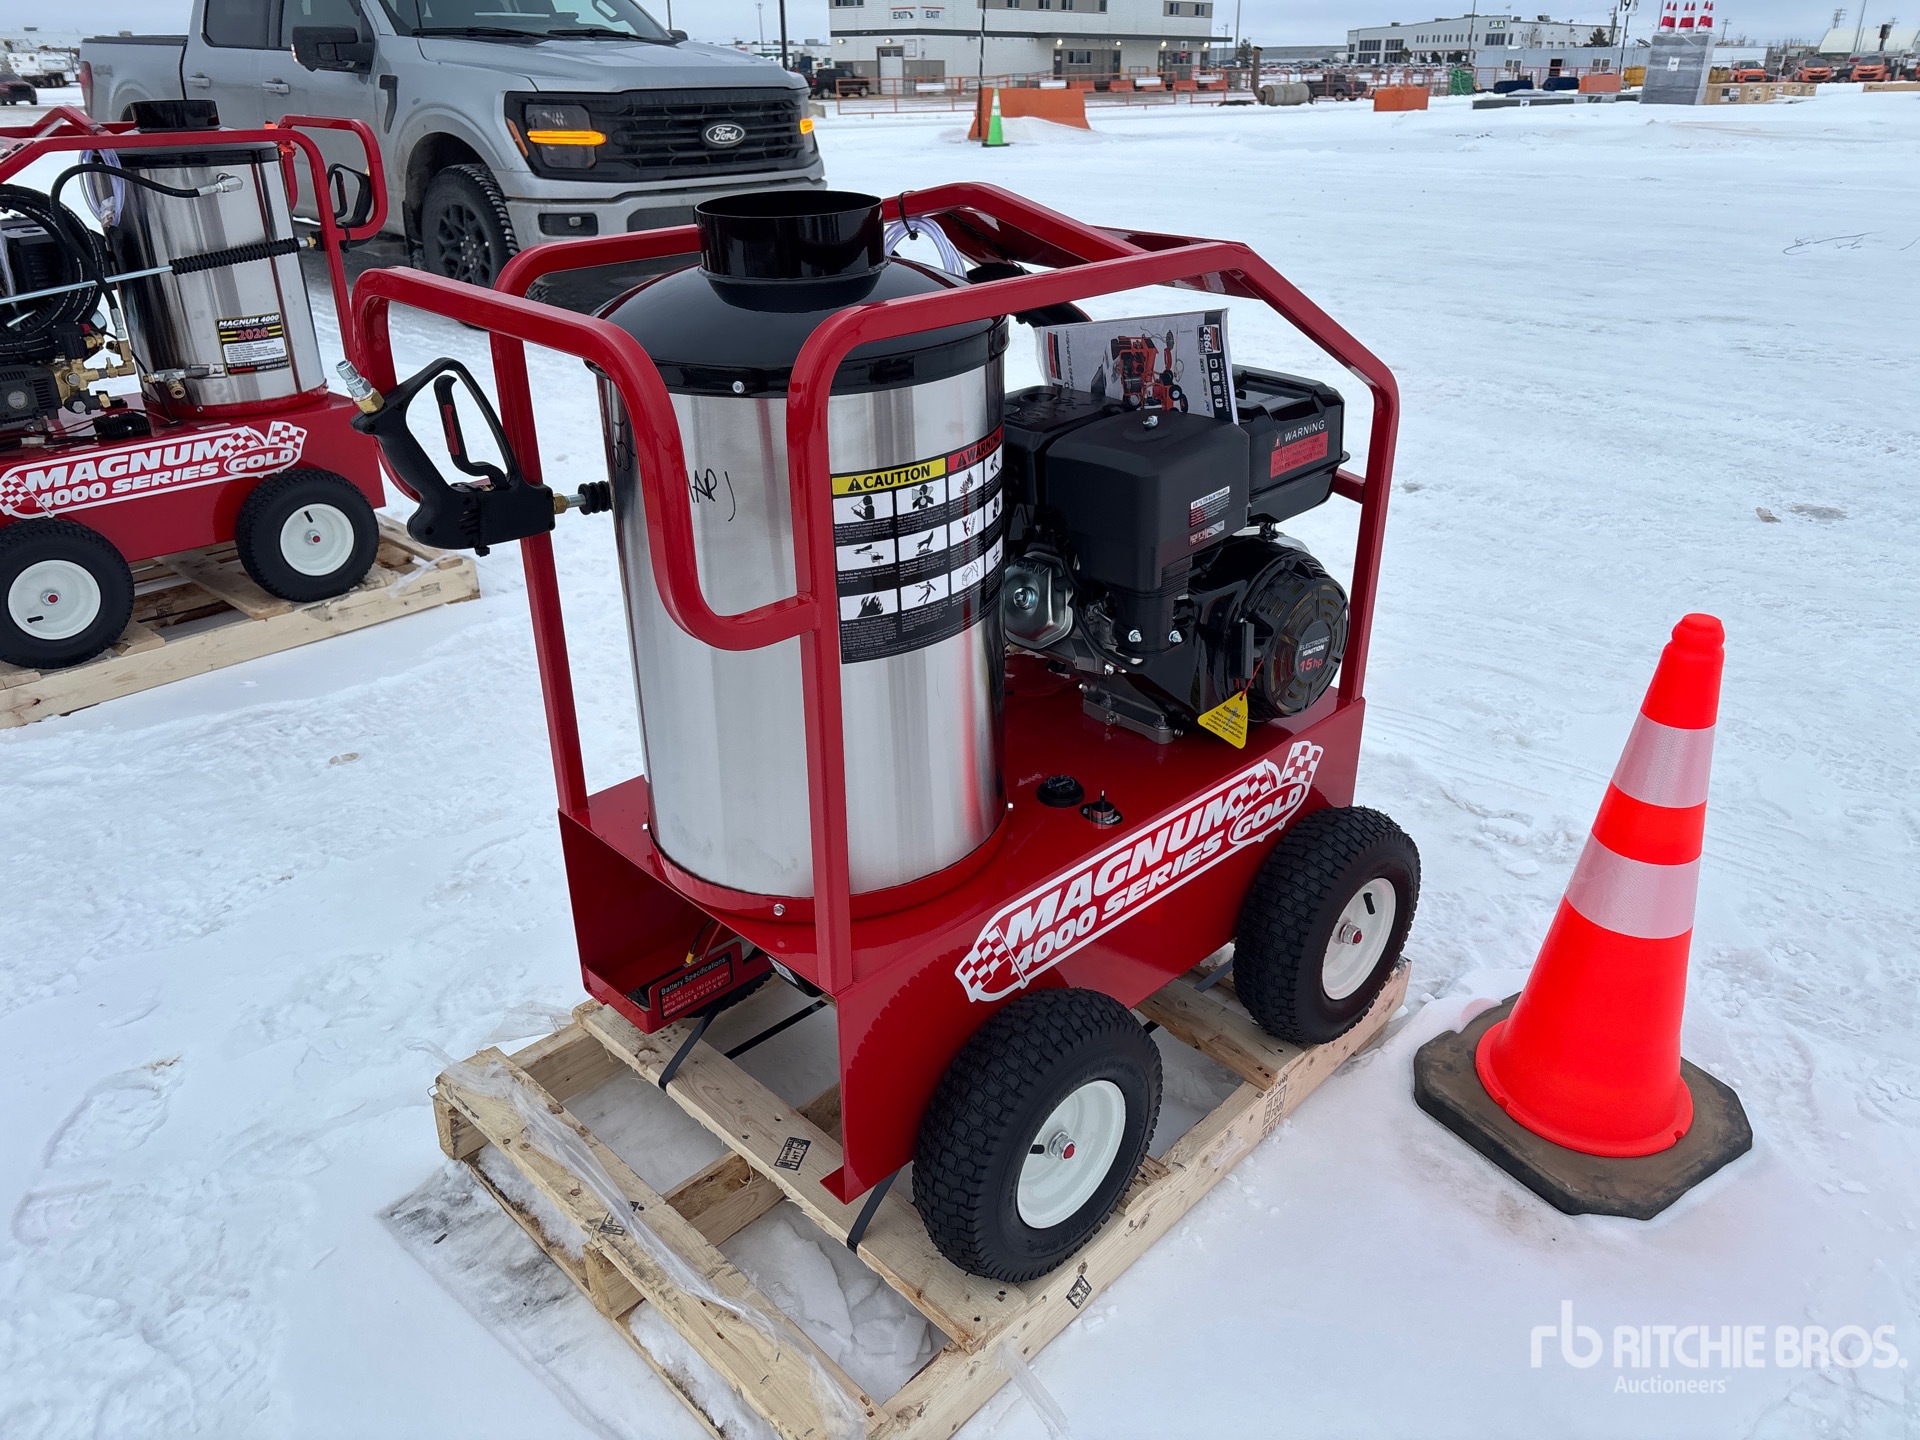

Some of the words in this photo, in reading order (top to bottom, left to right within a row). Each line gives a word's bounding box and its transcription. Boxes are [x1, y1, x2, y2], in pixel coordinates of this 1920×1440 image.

[713, 126, 738, 141] Ford
[218, 318, 259, 328] MAGNUM
[260, 314, 279, 323] 4000
[237, 327, 269, 341] 2026
[1203, 325, 1212, 353] 1982
[1284, 420, 1325, 442] WARNING
[966, 434, 1001, 462] WARNING
[25, 438, 232, 491] MAGNUM
[228, 450, 294, 472] GOLD
[36, 482, 107, 508] 4000
[111, 461, 219, 494] SERIES
[863, 464, 931, 489] CAUTION
[1299, 635, 1330, 650] ELECTRONIC
[1302, 643, 1325, 657] IGNITION
[1233, 788, 1301, 837] GOLD
[1003, 785, 1250, 948] MAGNUM
[1011, 905, 1098, 975] 4000
[1101, 829, 1225, 922] SERIES
[661, 978, 684, 996] Battery
